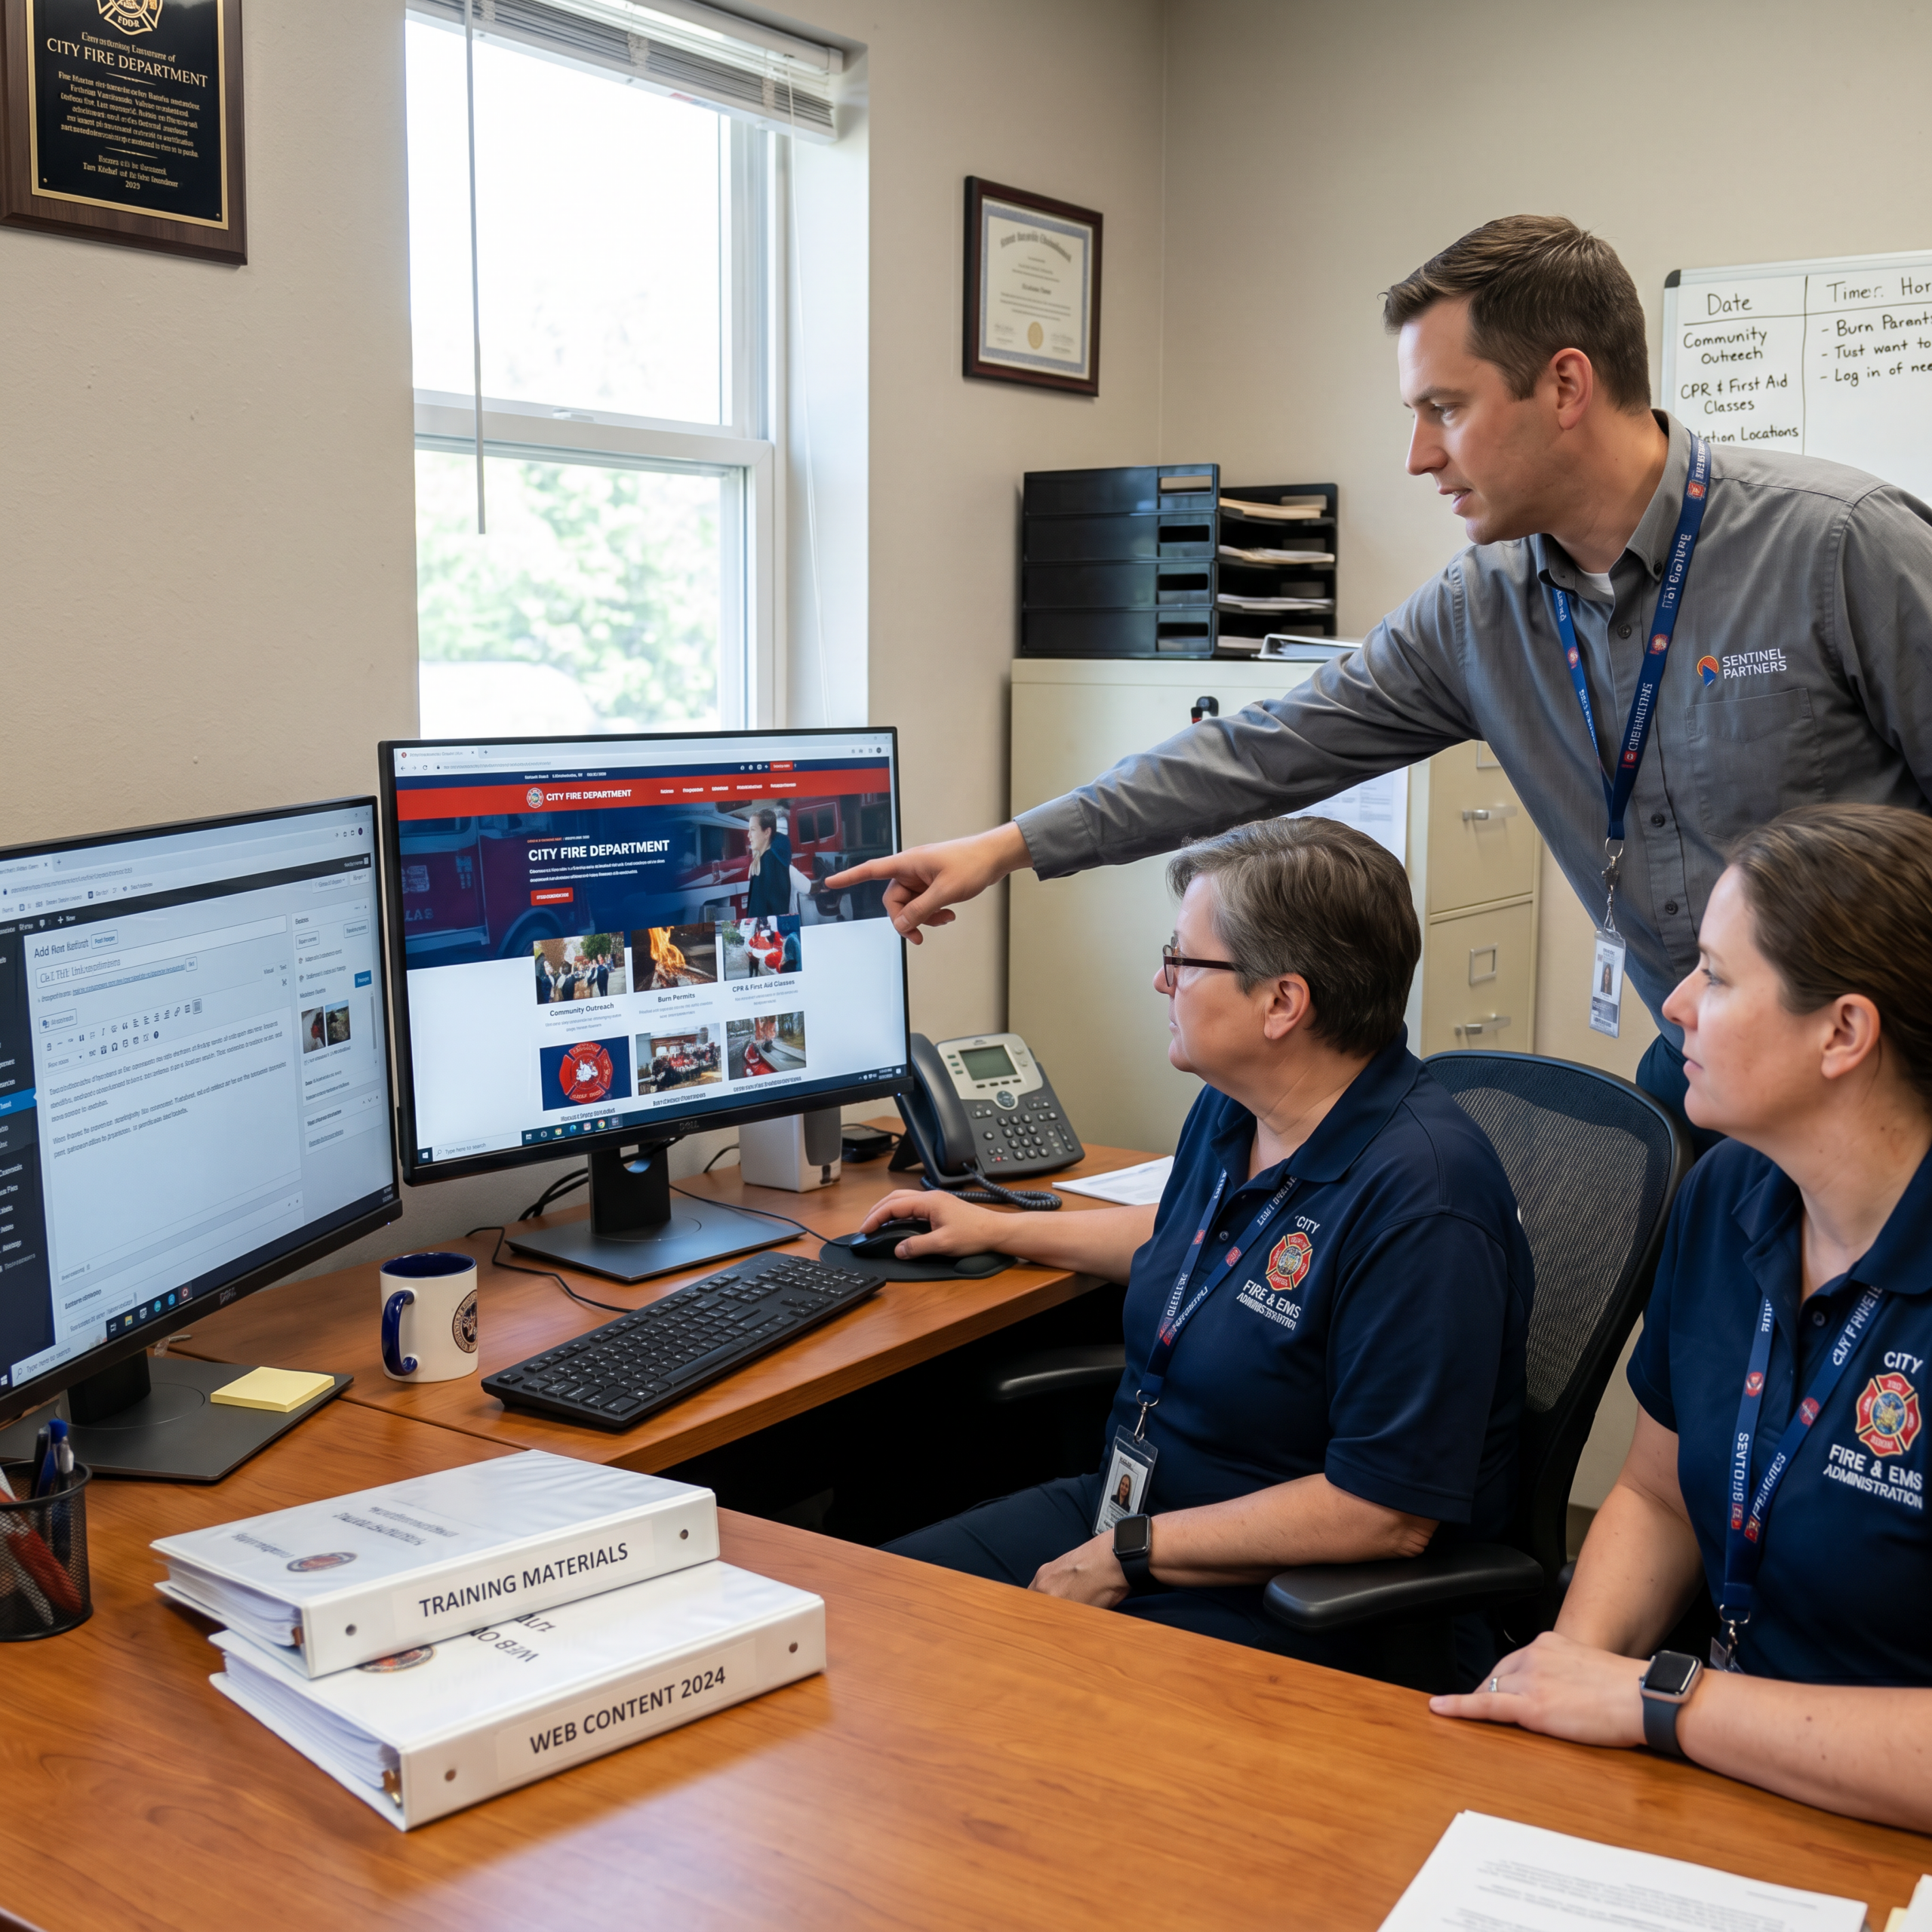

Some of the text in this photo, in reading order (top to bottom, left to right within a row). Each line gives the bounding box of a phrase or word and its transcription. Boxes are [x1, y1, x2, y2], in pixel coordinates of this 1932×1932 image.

[47, 38, 80, 57] CITY
[84, 47, 115, 66] FIRE
[118, 55, 208, 88] DEPARTMENT
[1707, 293, 1752, 315] Date
[1836, 319, 1874, 337] Burn
[1882, 311, 1932, 330] Parent
[1684, 326, 1767, 349] Community
[1874, 339, 1909, 355] want
[1917, 337, 1931, 349] to
[1835, 368, 1859, 387] Log
[1867, 366, 1881, 378] in
[1889, 361, 1903, 375] of
[1681, 383, 1712, 399] CPR
[1729, 377, 1760, 393] First
[1766, 373, 1788, 389] Aid
[1704, 400, 1755, 414] Classes
[1698, 424, 1799, 443] tation Locations
[1722, 648, 1786, 667] SENTINEL
[1723, 660, 1787, 679] PARTNERS
[546, 789, 632, 801] CITY FIRE DEPARTMENT
[528, 848, 558, 861] CITY
[561, 846, 587, 859] FIRE
[589, 839, 670, 857] DEPARTMENT
[34, 946, 49, 958] Add
[657, 992, 696, 1003] Burn Permits
[549, 1003, 614, 1017] Community Outreach
[1242, 1279, 1302, 1319] FIRE & EMS
[1884, 1351, 1924, 1374] CITY
[1829, 1444, 1923, 1491] FIRE & EMS
[1823, 1463, 1923, 1509] ADMINISTRATION
[419, 1543, 629, 1617] TRAINING MATERIALS
[530, 1666, 726, 1754] WEB CONTENT 2024
